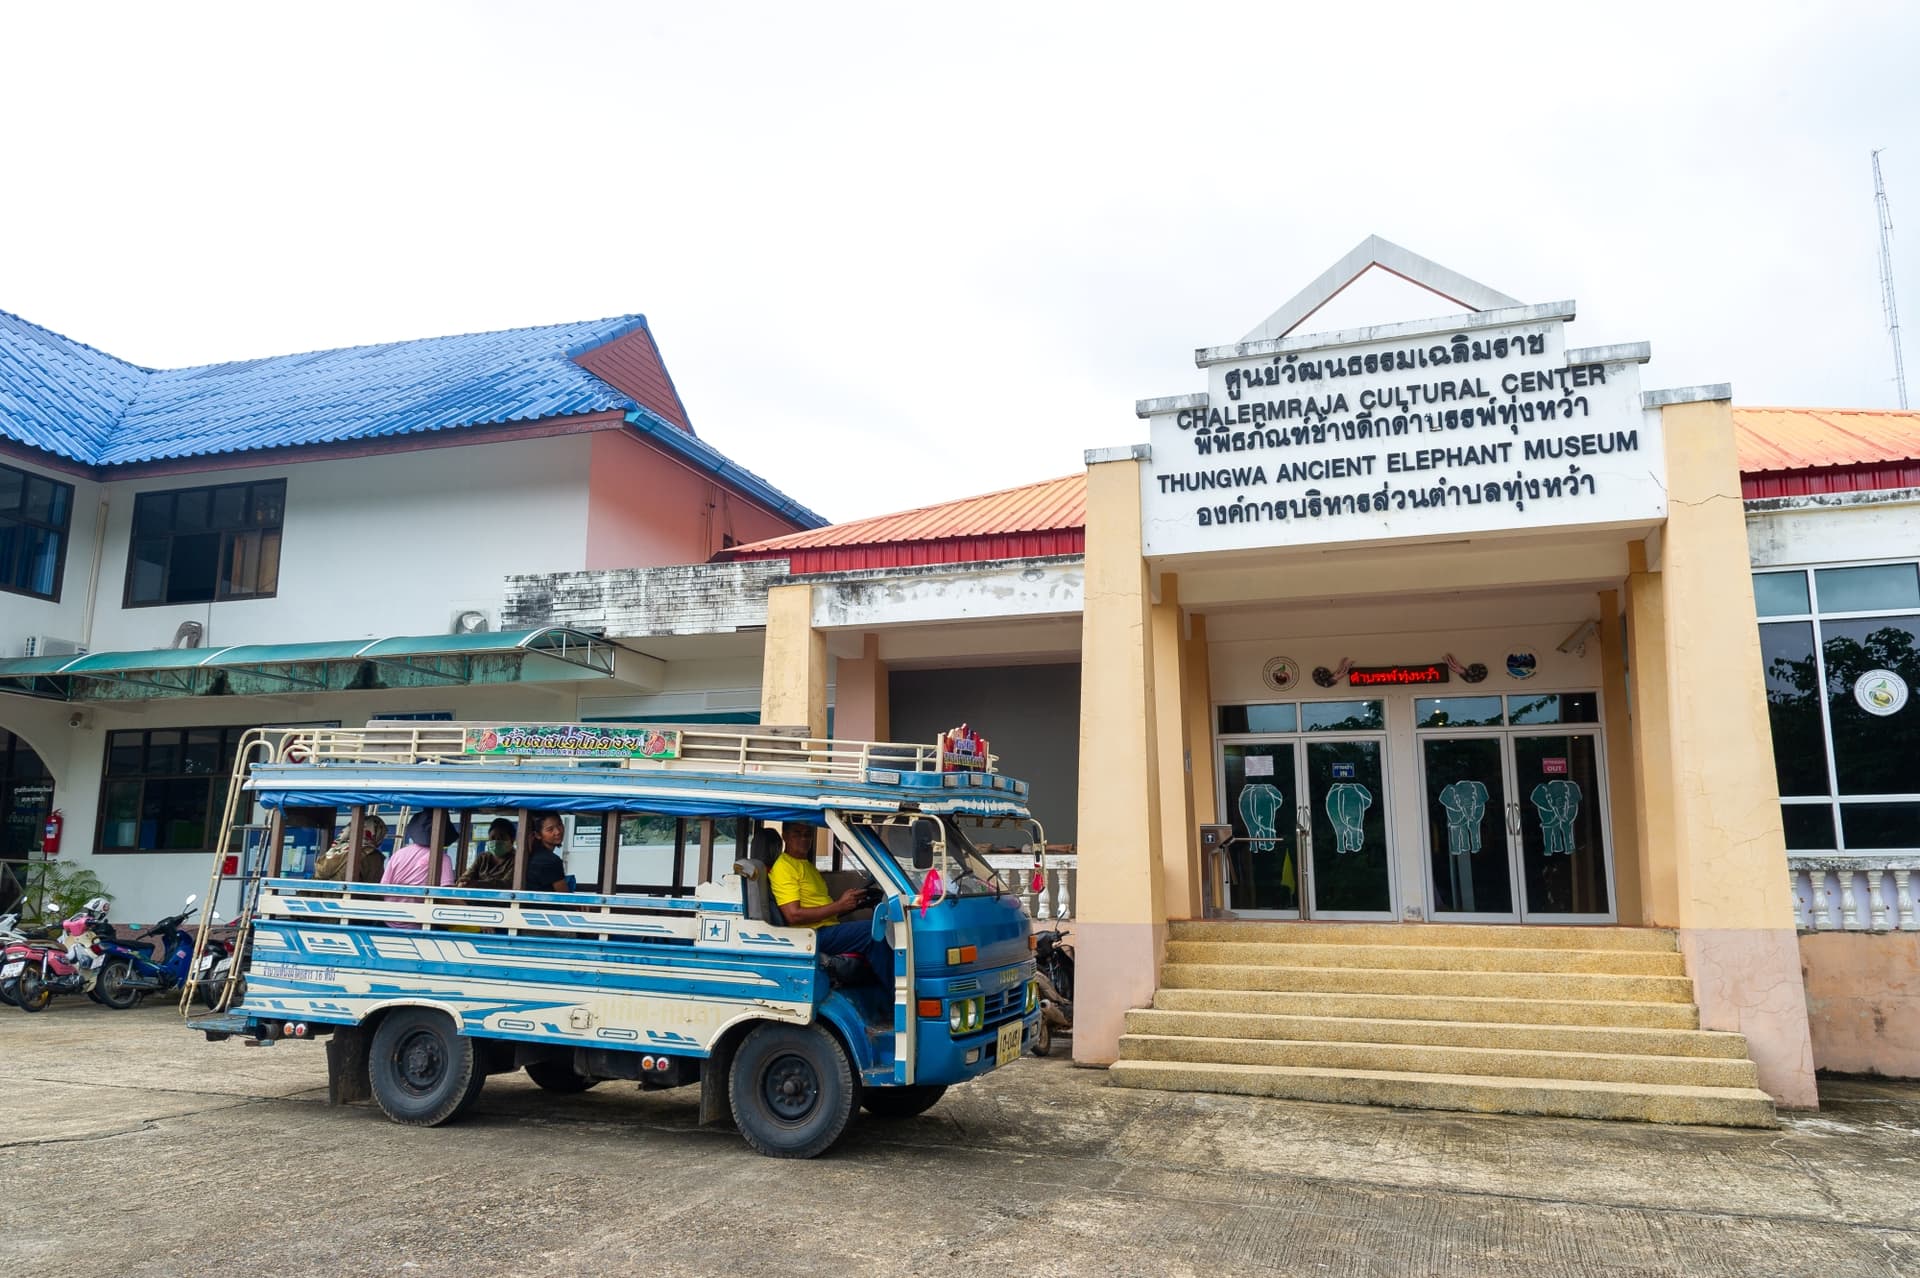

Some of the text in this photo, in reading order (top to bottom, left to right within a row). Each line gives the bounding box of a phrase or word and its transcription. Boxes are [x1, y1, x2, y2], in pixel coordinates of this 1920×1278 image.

[1177, 363, 1606, 430] CHALERMRAJA CULTURAL CENTER
[1225, 333, 1545, 400] ศูนย์วัฒนธรรมเฉลิมราช
[1157, 430, 1638, 494] THUNGWA ANCIENT ELEPHANT MUSEUM
[1197, 464, 1595, 527] องค์การบริหารส่วนตำบลทุ่งหว้า
